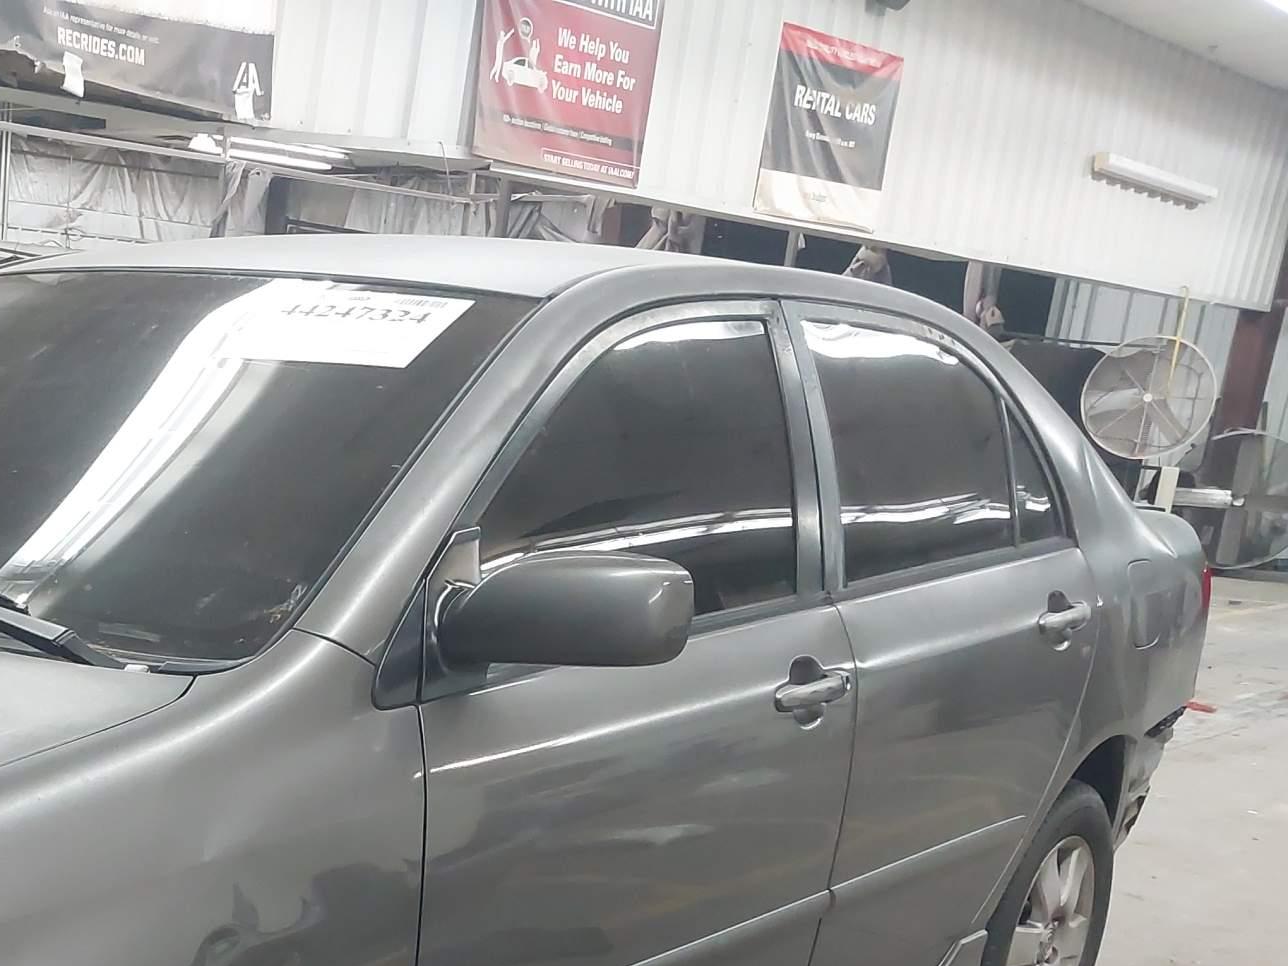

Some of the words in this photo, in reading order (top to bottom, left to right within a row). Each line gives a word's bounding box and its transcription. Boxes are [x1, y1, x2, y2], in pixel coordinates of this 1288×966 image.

[57, 26, 145, 66] RECRIDES.COM
[558, 27, 577, 49] We
[579, 33, 606, 61] Help
[609, 41, 630, 64] You
[554, 54, 580, 79] Earn
[584, 61, 614, 86] More
[616, 71, 636, 92] For
[551, 80, 578, 104] Your
[581, 87, 623, 114] Vehicle
[845, 102, 876, 126] CARS
[281, 304, 432, 324] 44247324
